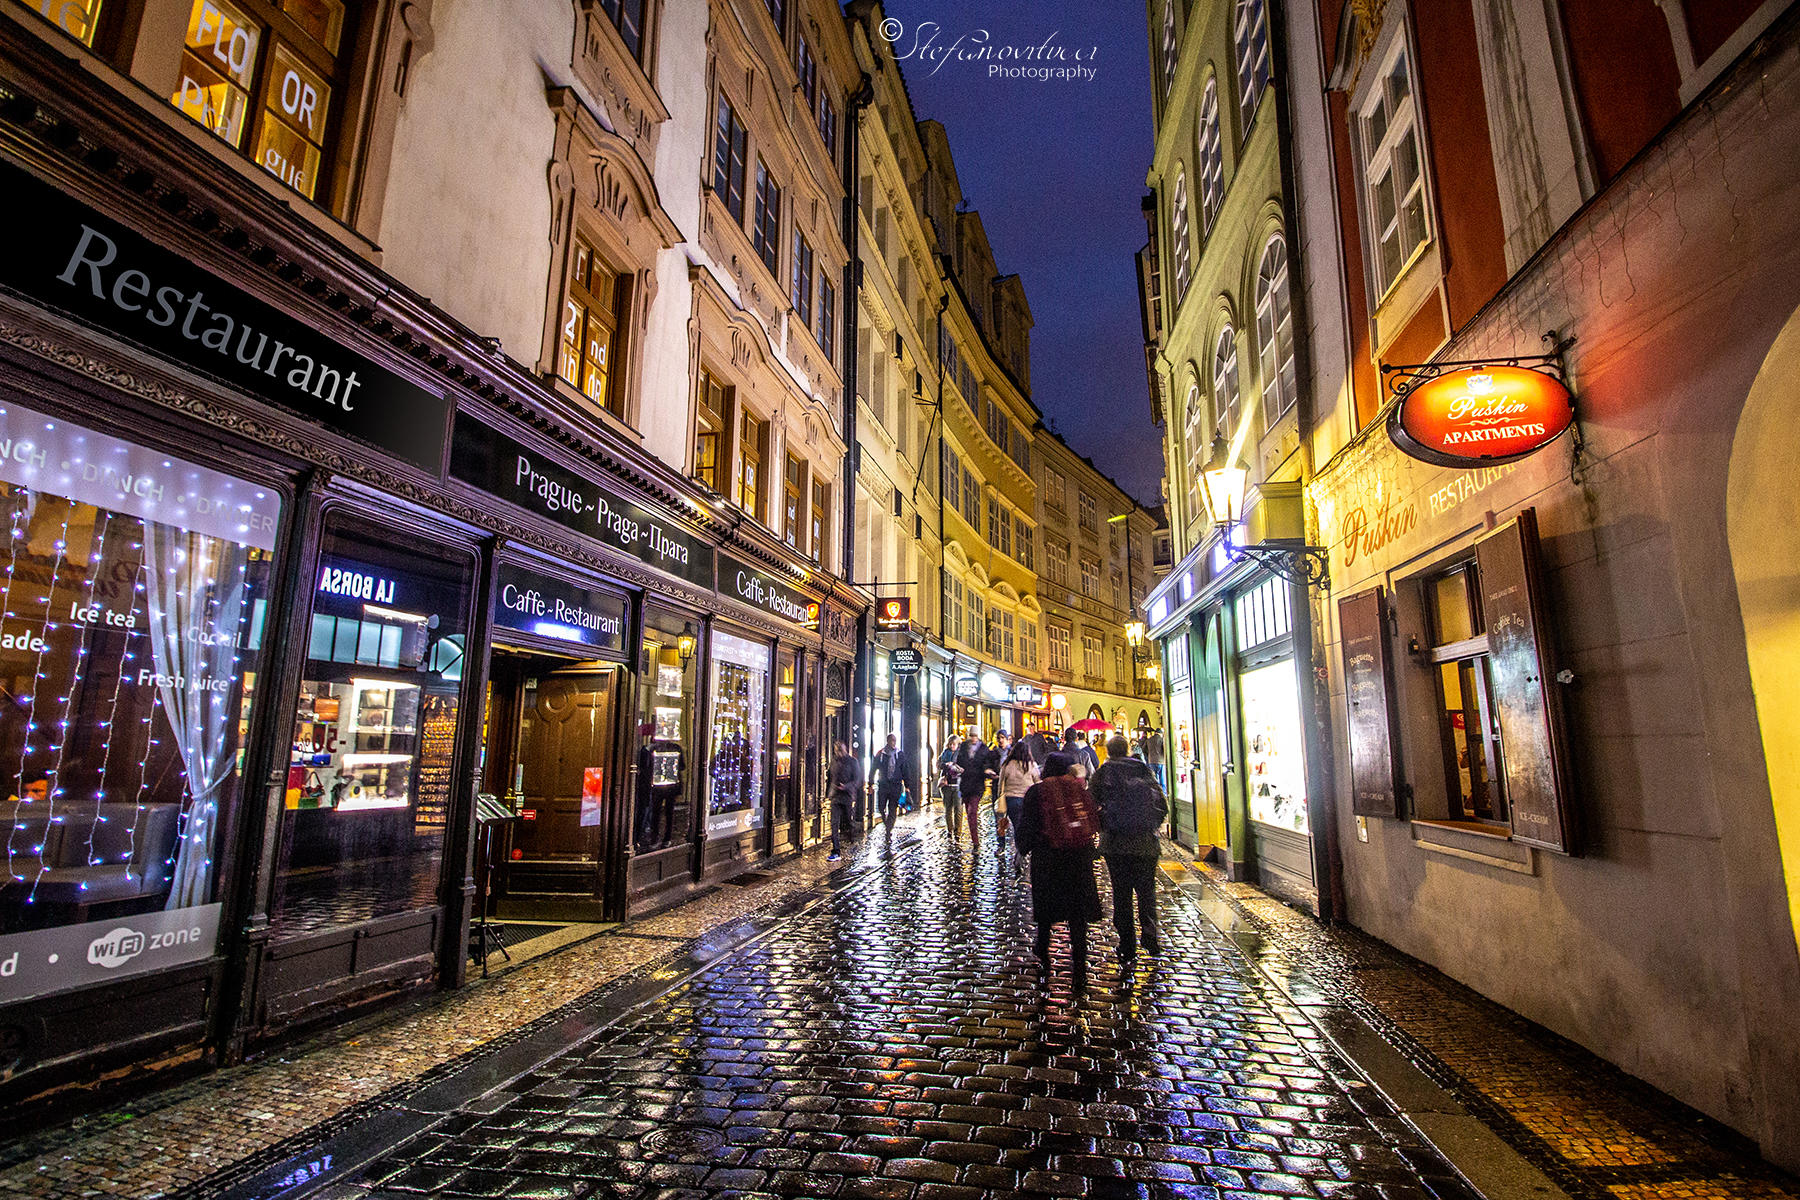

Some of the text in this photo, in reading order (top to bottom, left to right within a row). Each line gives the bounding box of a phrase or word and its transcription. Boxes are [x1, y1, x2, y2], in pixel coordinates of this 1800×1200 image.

[56, 223, 362, 412] Restaurant
[1447, 395, 1528, 420] Puškin
[1442, 423, 1546, 445] APARTMENTS
[516, 455, 583, 512] Prague
[597, 498, 639, 544] Praga
[649, 524, 689, 565] Прага
[1342, 492, 1418, 568] Puškin
[737, 570, 764, 604] Caffe
[769, 586, 809, 623] Restaurant
[70, 602, 137, 628] Ice tea
[502, 584, 546, 616] Caffe
[555, 598, 620, 636] Restaurant
[1493, 612, 1525, 635] Coffee Tea
[1, 629, 44, 652] ade
[1349, 653, 1374, 667] Baguette
[137, 668, 229, 695] Fresh juice
[1351, 681, 1376, 693] Baguette
[149, 926, 201, 950] zone
